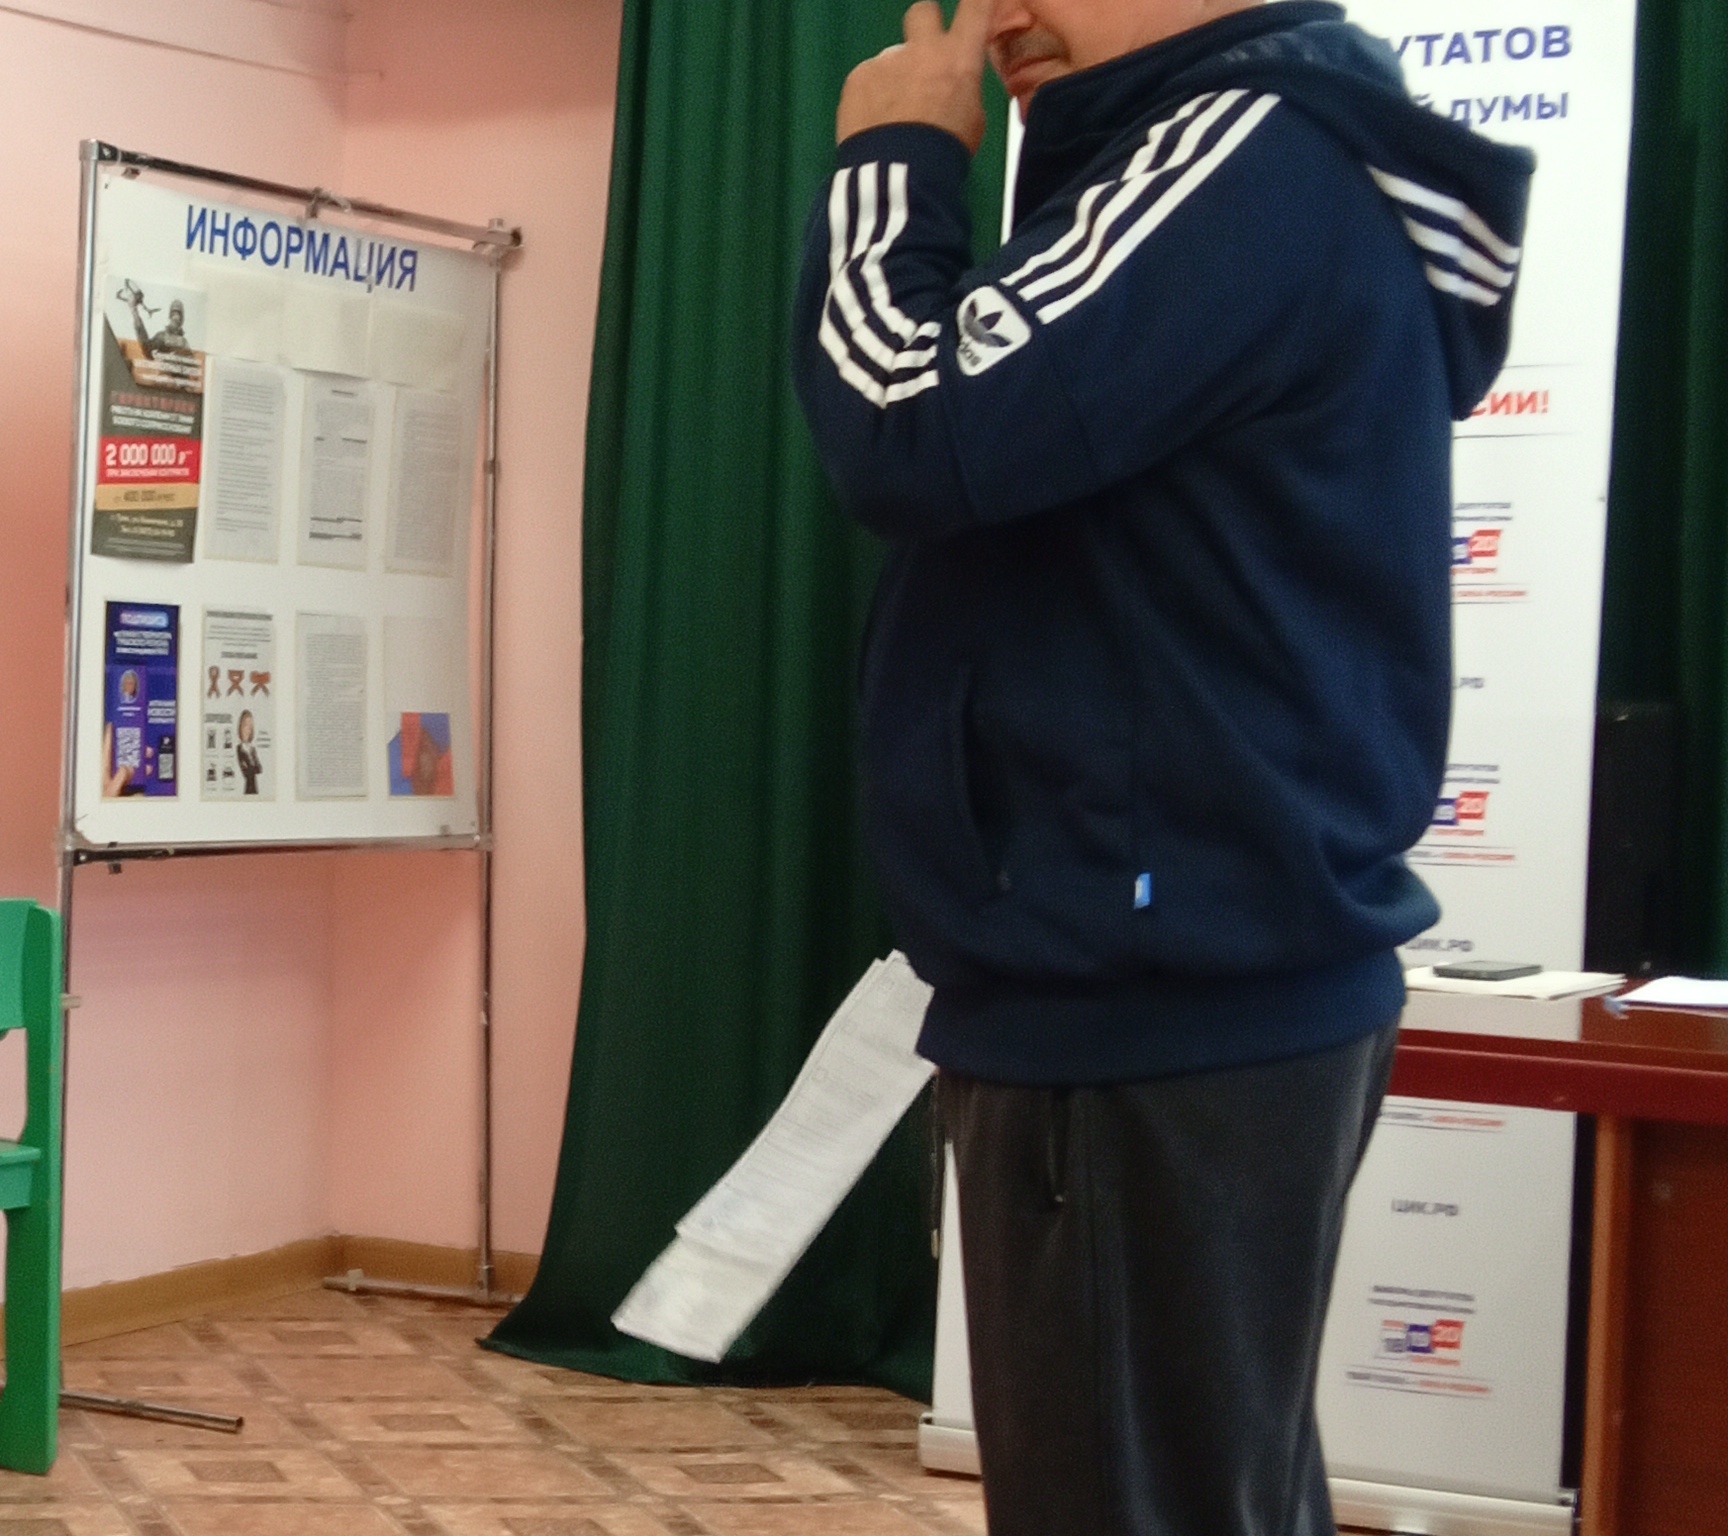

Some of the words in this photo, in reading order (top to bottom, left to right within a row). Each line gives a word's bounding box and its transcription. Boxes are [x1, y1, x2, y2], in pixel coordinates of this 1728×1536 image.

[1449, 91, 1570, 126] ДУМЫ
[185, 204, 418, 293] ИНФОРМАЦИЯ
[105, 443, 117, 466] 2
[119, 443, 149, 466] 000
[150, 443, 177, 466] 000
